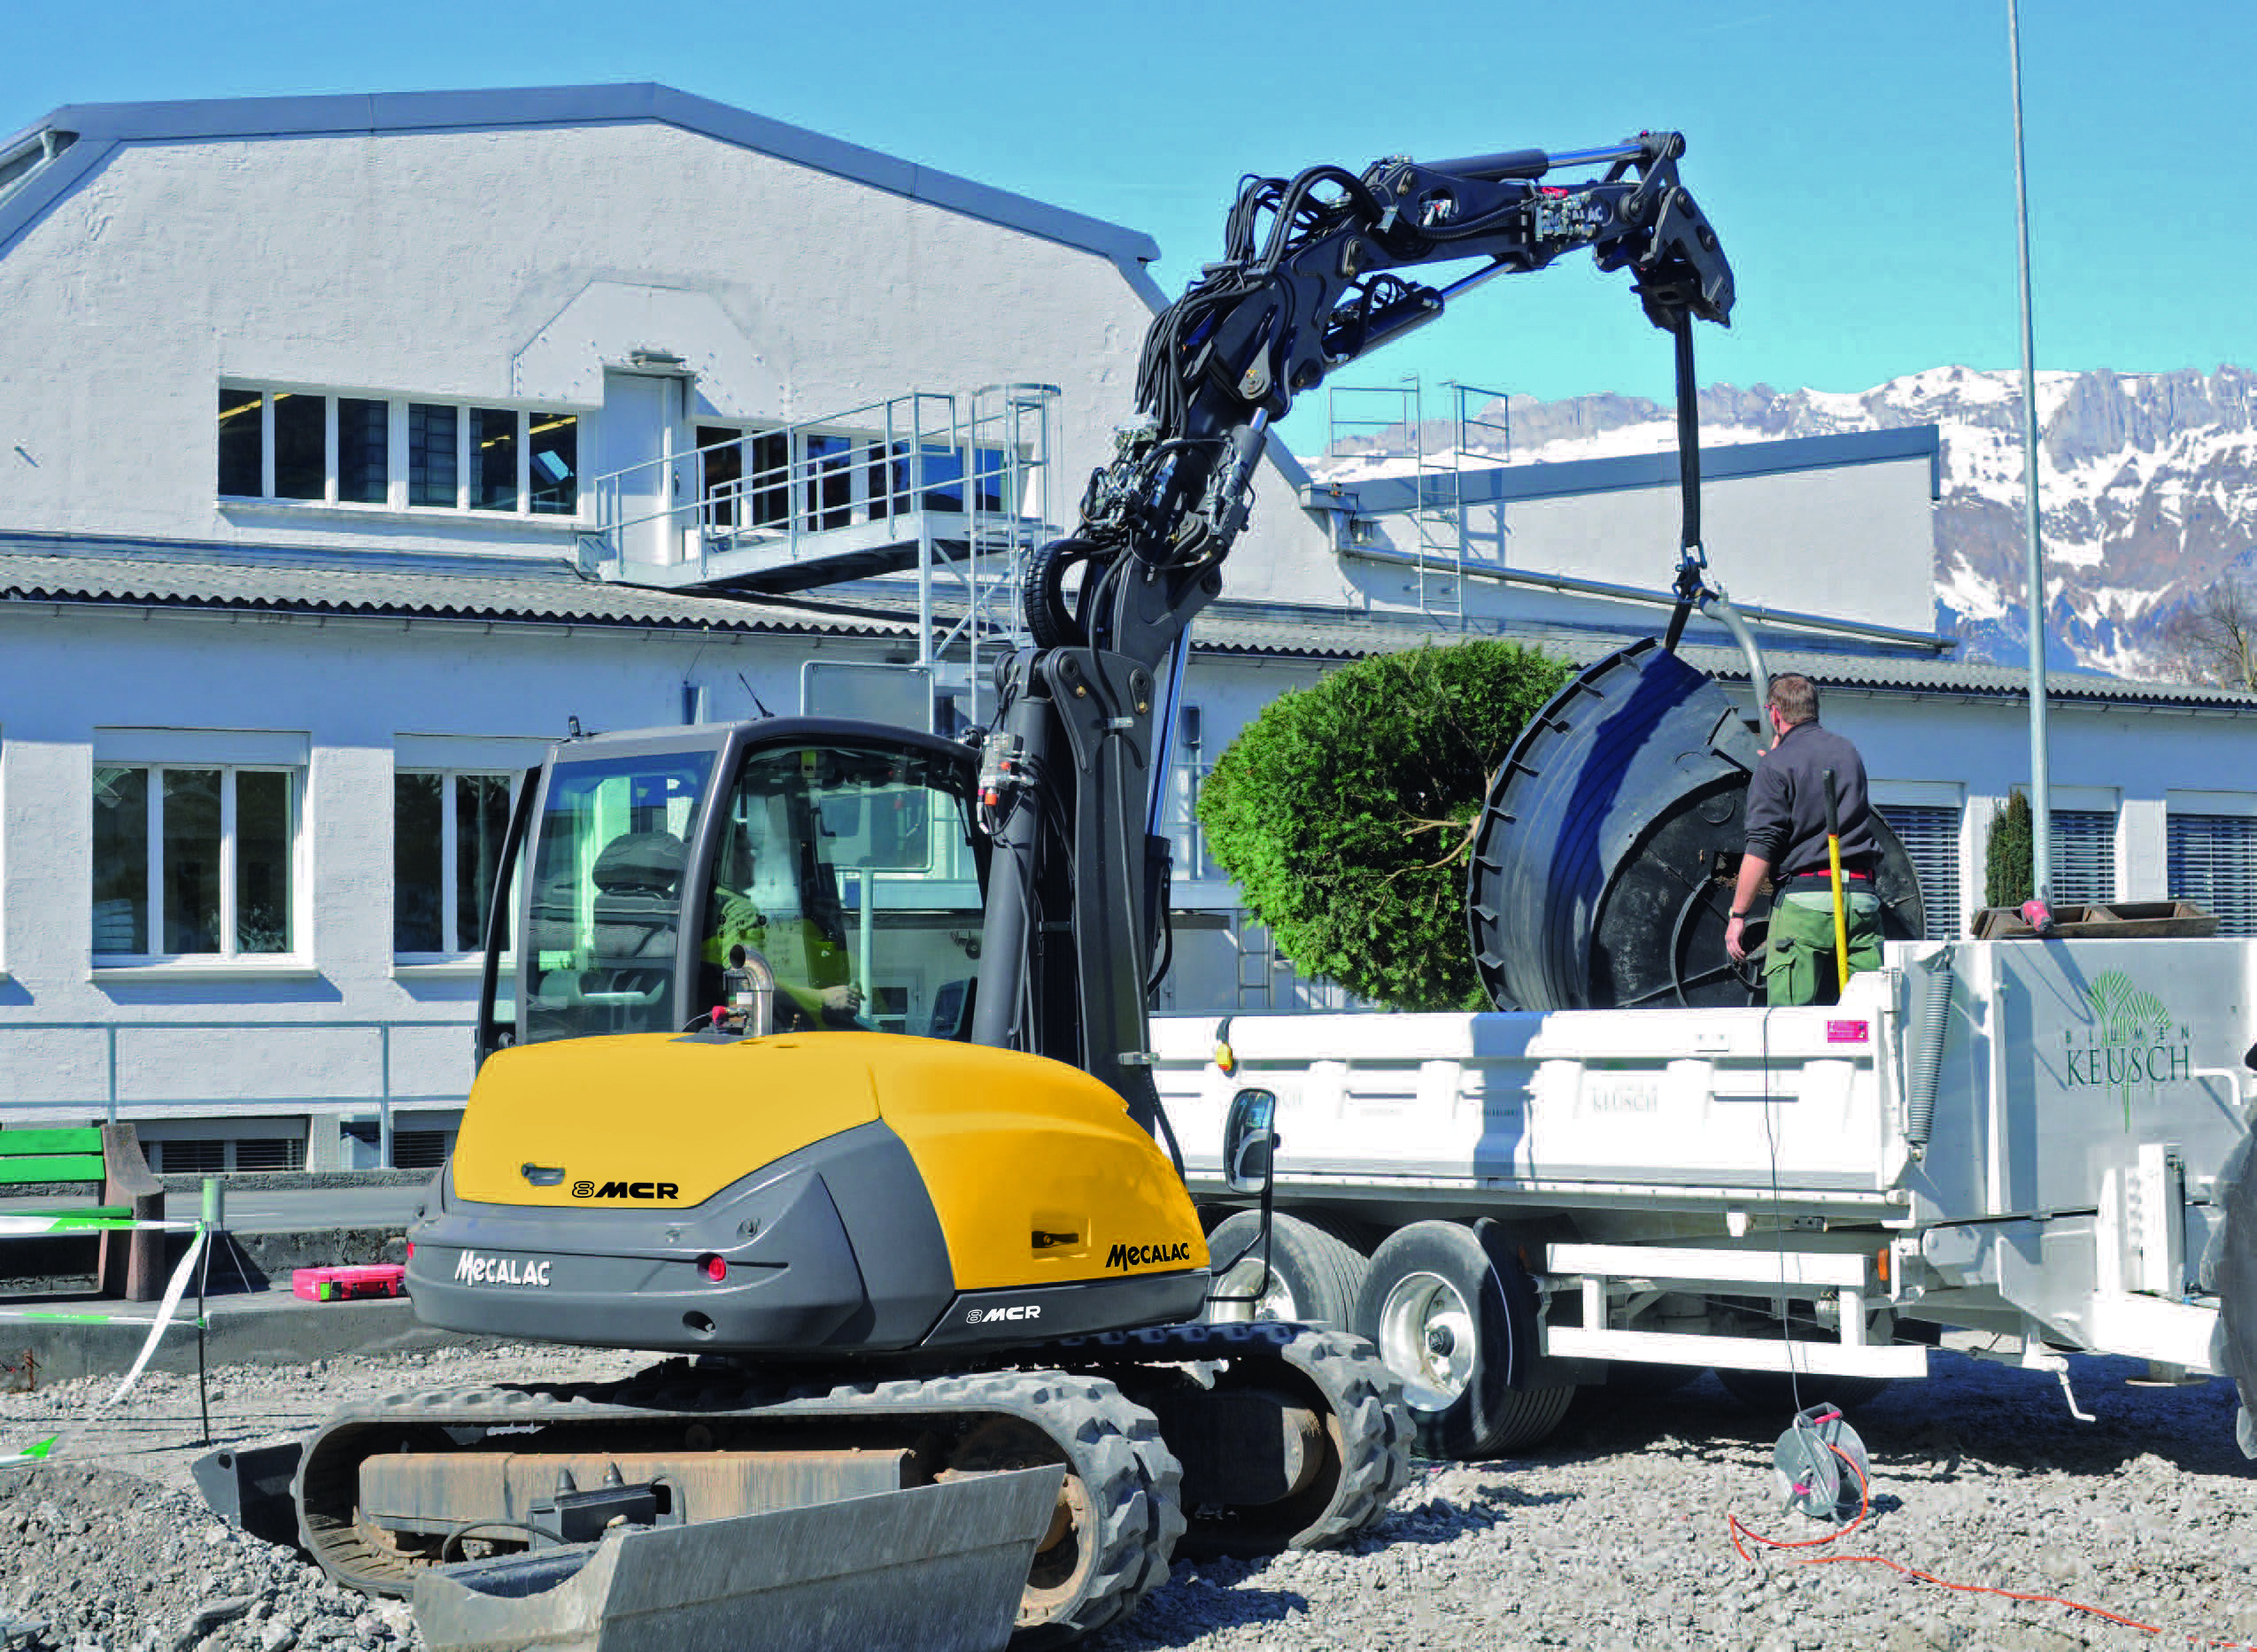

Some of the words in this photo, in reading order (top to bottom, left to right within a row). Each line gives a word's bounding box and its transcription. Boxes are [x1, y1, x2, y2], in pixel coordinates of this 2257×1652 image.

[2065, 1026, 2190, 1044] BLUMEN
[2067, 1045, 2191, 1086] KEUSCH
[571, 1180, 679, 1200] 8MCR
[966, 1305, 1041, 1324] 8MCR
